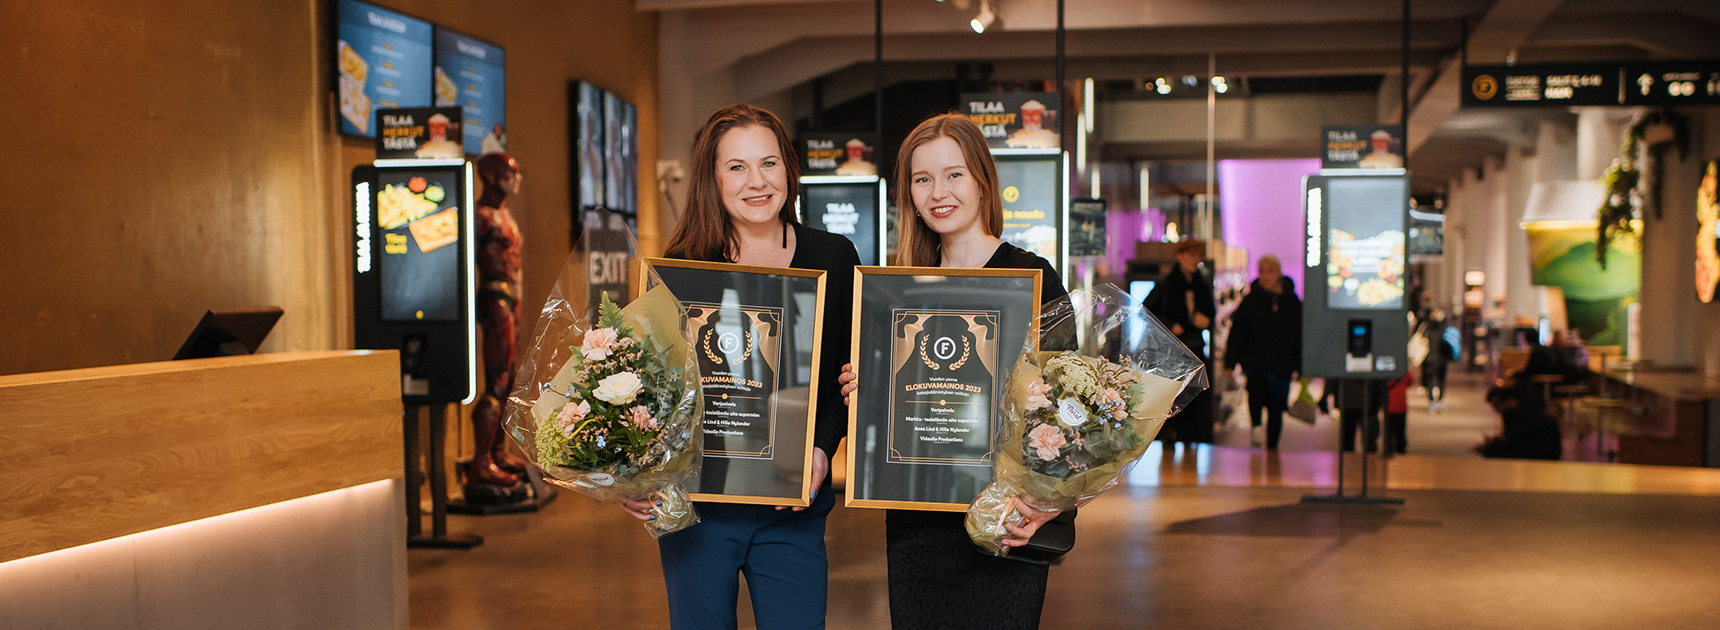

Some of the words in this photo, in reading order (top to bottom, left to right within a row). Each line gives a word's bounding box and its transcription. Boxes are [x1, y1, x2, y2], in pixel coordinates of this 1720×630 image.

[969, 101, 1004, 113] TILAA
[382, 115, 414, 126] TILAA
[970, 113, 1017, 125] HERKUT
[383, 125, 425, 137] HERKUT
[978, 124, 1007, 138] ÄSTÄ
[1327, 131, 1357, 140] TILAA
[807, 139, 835, 149] TILAA
[590, 252, 628, 284] EXIT
[701, 376, 746, 385] KUVAMAINOS
[747, 380, 763, 388] 2023
[905, 382, 964, 392] ELOKUVAMAINOS
[964, 385, 982, 393] 2023
